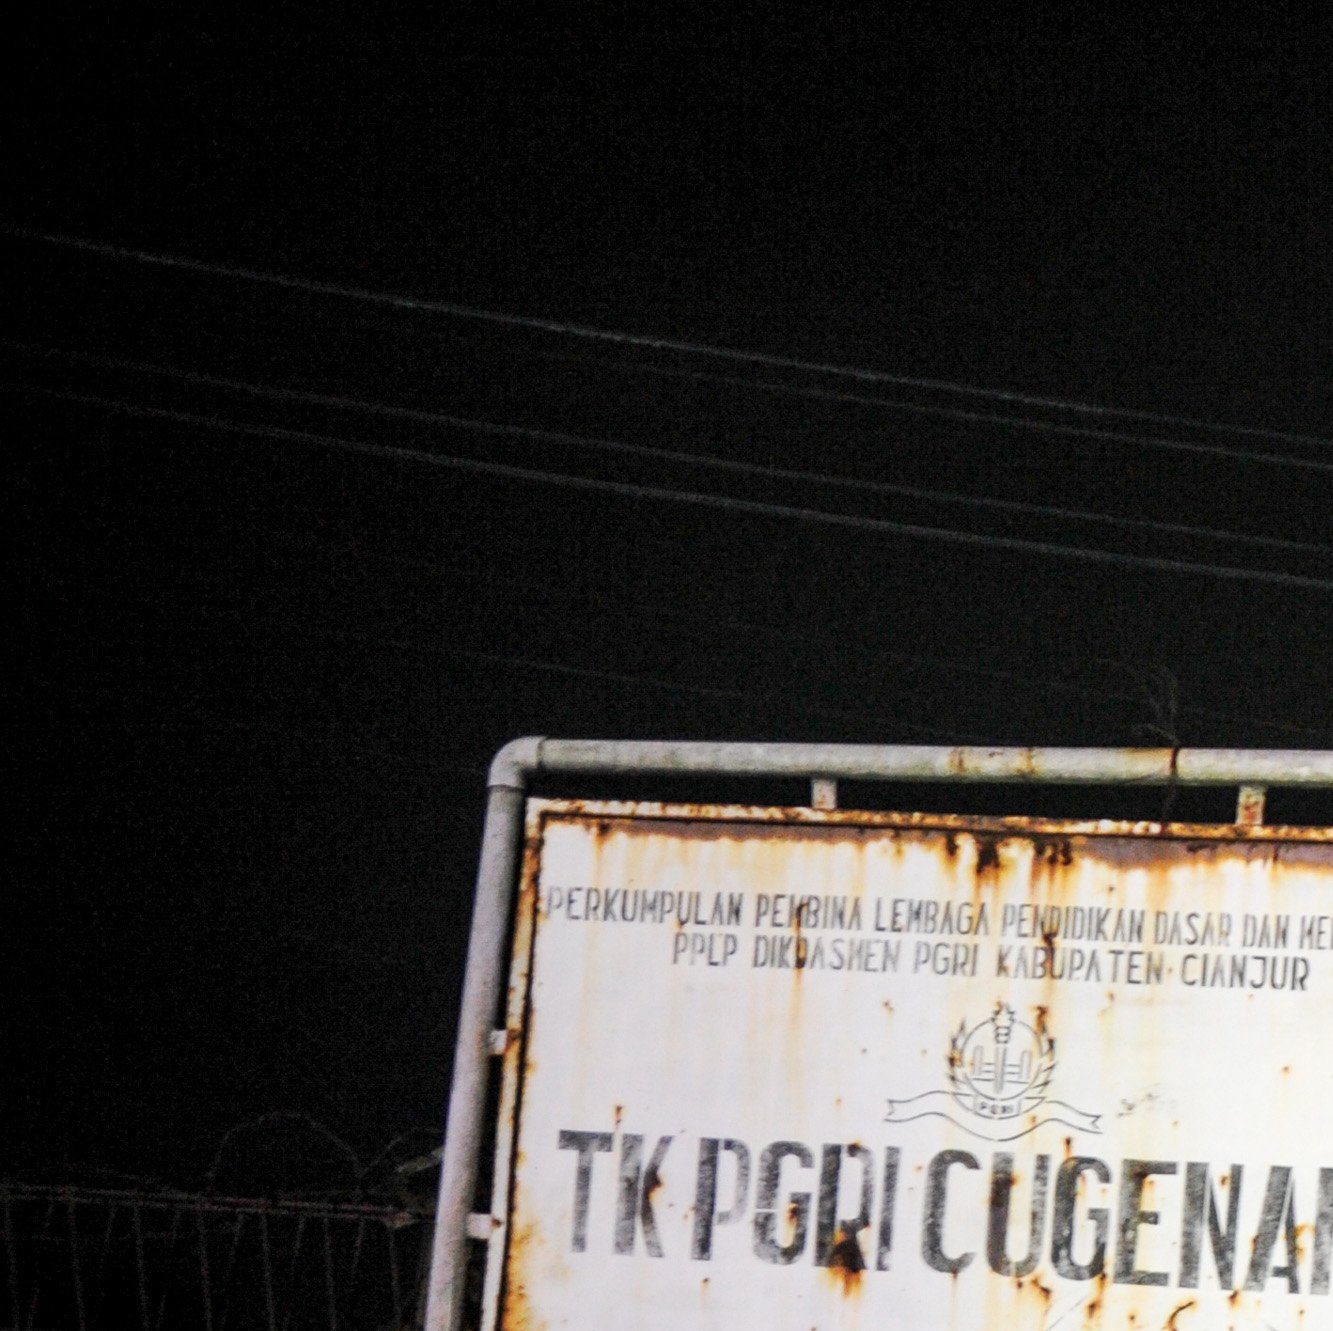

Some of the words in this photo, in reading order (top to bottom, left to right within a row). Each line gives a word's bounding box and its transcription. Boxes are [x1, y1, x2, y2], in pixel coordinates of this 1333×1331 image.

[546, 887, 743, 927] PERKUMPULAN
[755, 892, 863, 931] PEMBINA
[874, 898, 989, 936] LEMBAGA
[1002, 903, 1145, 945] PENDIDIKAN
[1154, 910, 1232, 948] DASAR
[1243, 913, 1289, 950] DAN
[672, 933, 738, 966] PPLP
[752, 935, 900, 974] DIKDASMEN
[913, 941, 980, 978] PGRI
[996, 947, 1164, 986] KABUPATEN
[1181, 954, 1311, 992] CIANJUR
[559, 1130, 672, 1259] TK
[691, 1137, 903, 1273] PGRI
